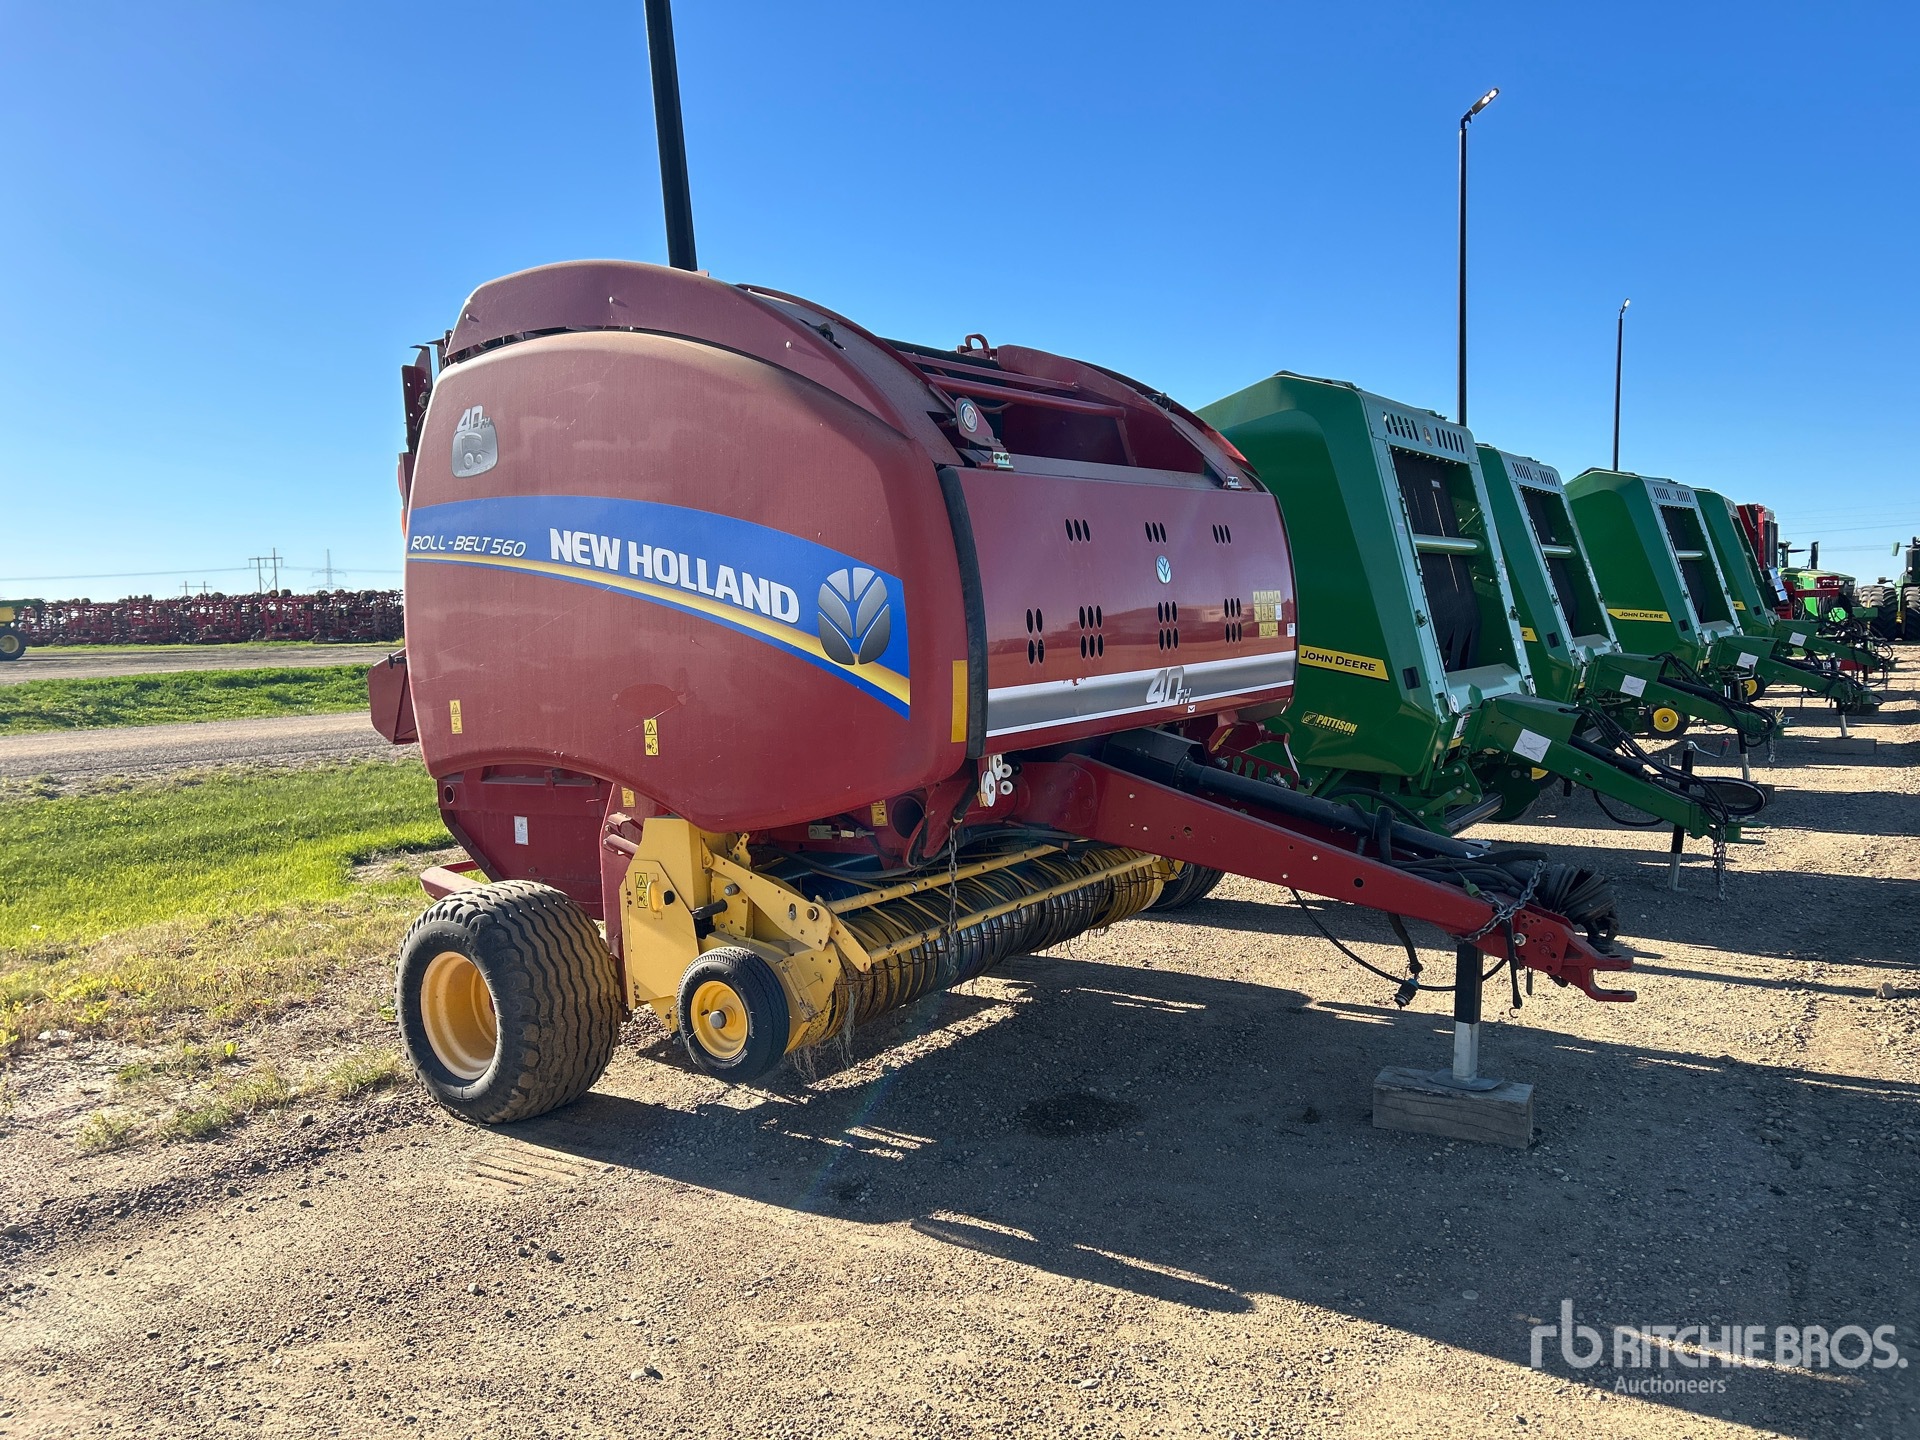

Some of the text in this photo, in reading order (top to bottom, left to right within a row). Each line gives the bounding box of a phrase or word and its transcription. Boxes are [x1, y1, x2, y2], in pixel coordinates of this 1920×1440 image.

[410, 535, 527, 557] ROLL-BELT 560
[549, 527, 800, 624] NEW HOLLAND
[1301, 650, 1376, 671] JOHN DEERE
[1316, 714, 1358, 733] PATTISON
